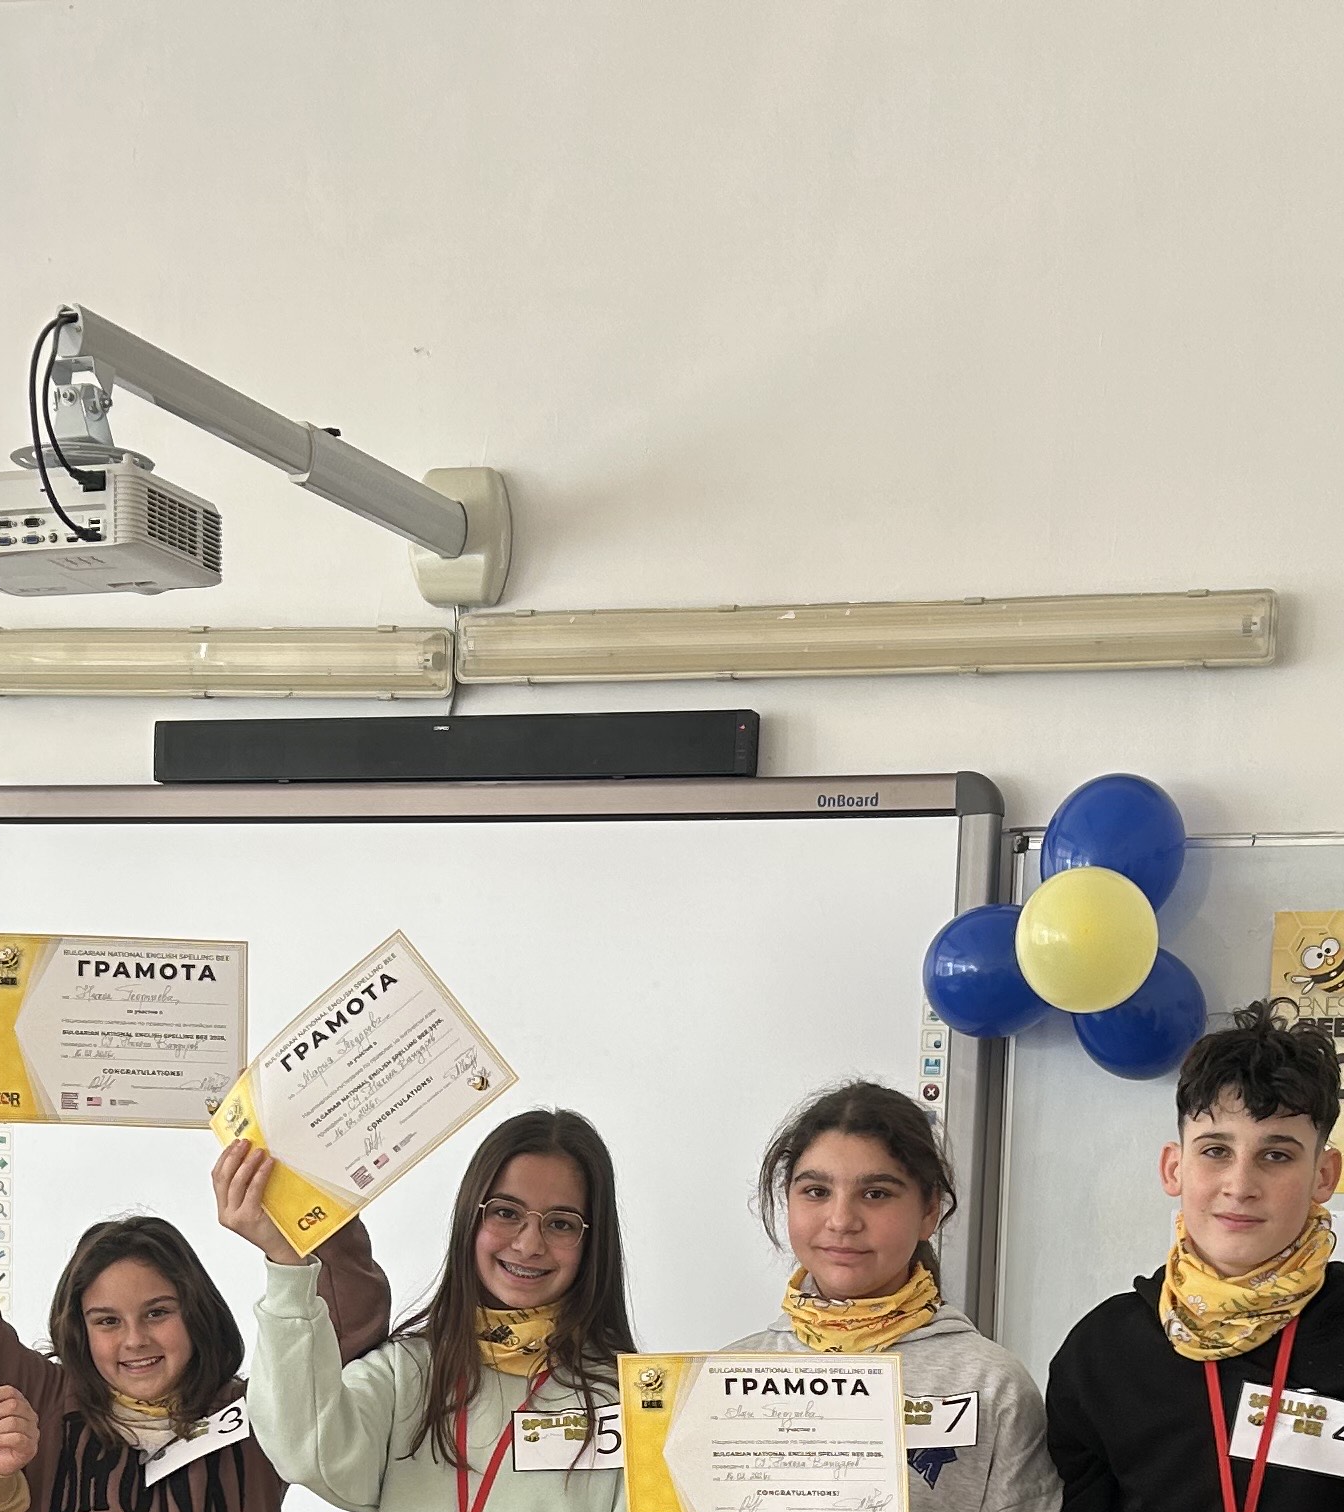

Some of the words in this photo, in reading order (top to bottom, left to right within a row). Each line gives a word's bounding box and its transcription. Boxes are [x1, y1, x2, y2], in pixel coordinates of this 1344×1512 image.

[817, 792, 879, 807] OnBoard
[77, 960, 217, 981] ГРАМОТА
[264, 1036, 298, 1069] BULGARIAN
[298, 1009, 330, 1039] NATIONAL
[329, 989, 355, 1012] ENGLISH
[354, 965, 382, 990] SPELLING
[280, 973, 398, 1072] ГРАМОТА
[103, 1068, 183, 1076] CONGRATULATIONS!
[367, 1076, 434, 1132] CONGRATULATIONS!
[724, 1377, 870, 1397] ГРАМОТА
[218, 1406, 243, 1434] 3
[942, 1397, 971, 1433] 7
[1248, 1393, 1327, 1420] SPLLING
[522, 1416, 588, 1430] SPELLING
[597, 1414, 622, 1454] 5
[757, 1489, 840, 1497] CONGRATULATIONS!
